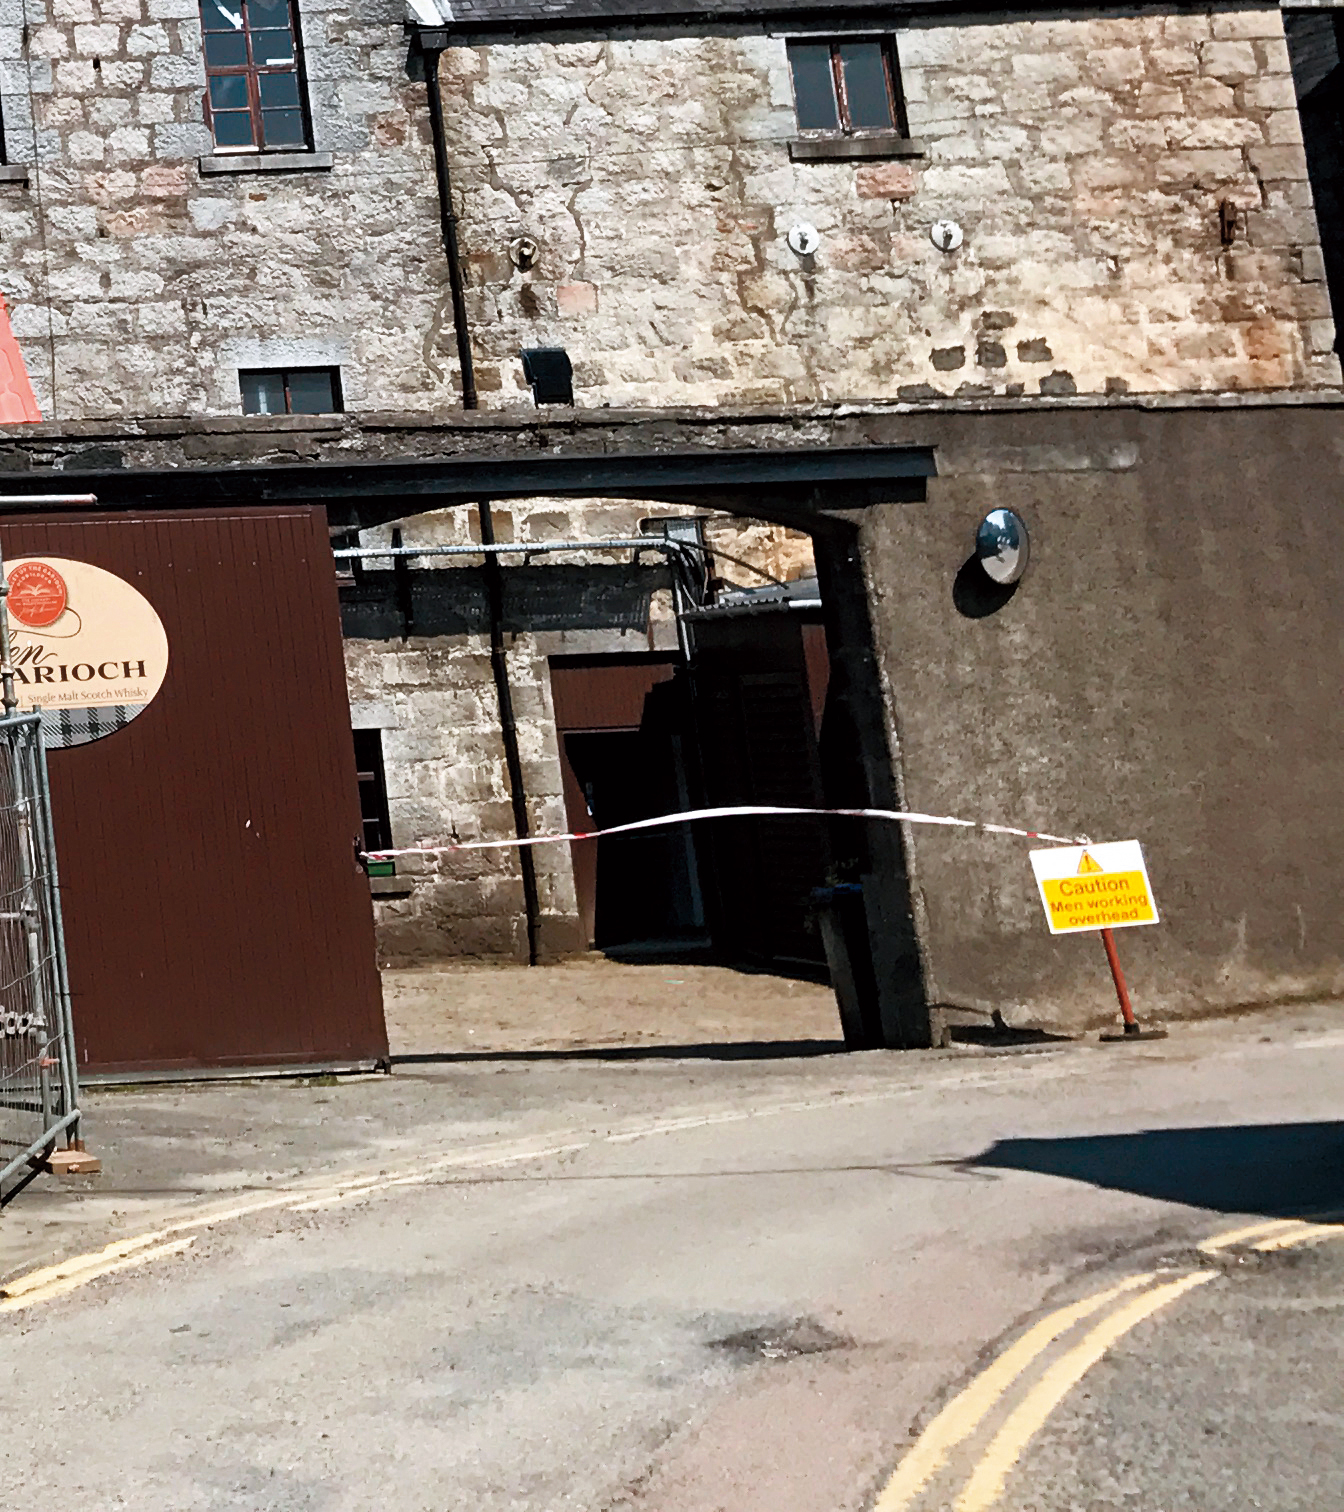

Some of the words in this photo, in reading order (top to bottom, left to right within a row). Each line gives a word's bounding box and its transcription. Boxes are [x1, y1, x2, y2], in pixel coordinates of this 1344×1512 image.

[27, 692, 56, 703] Single
[58, 692, 78, 701] Malt
[80, 689, 113, 699] Scotch
[115, 686, 149, 698] Whisky
[1059, 878, 1130, 896] Caution
[1051, 901, 1084, 912] Men
[1087, 894, 1148, 909] working
[1069, 908, 1138, 925] overhead
